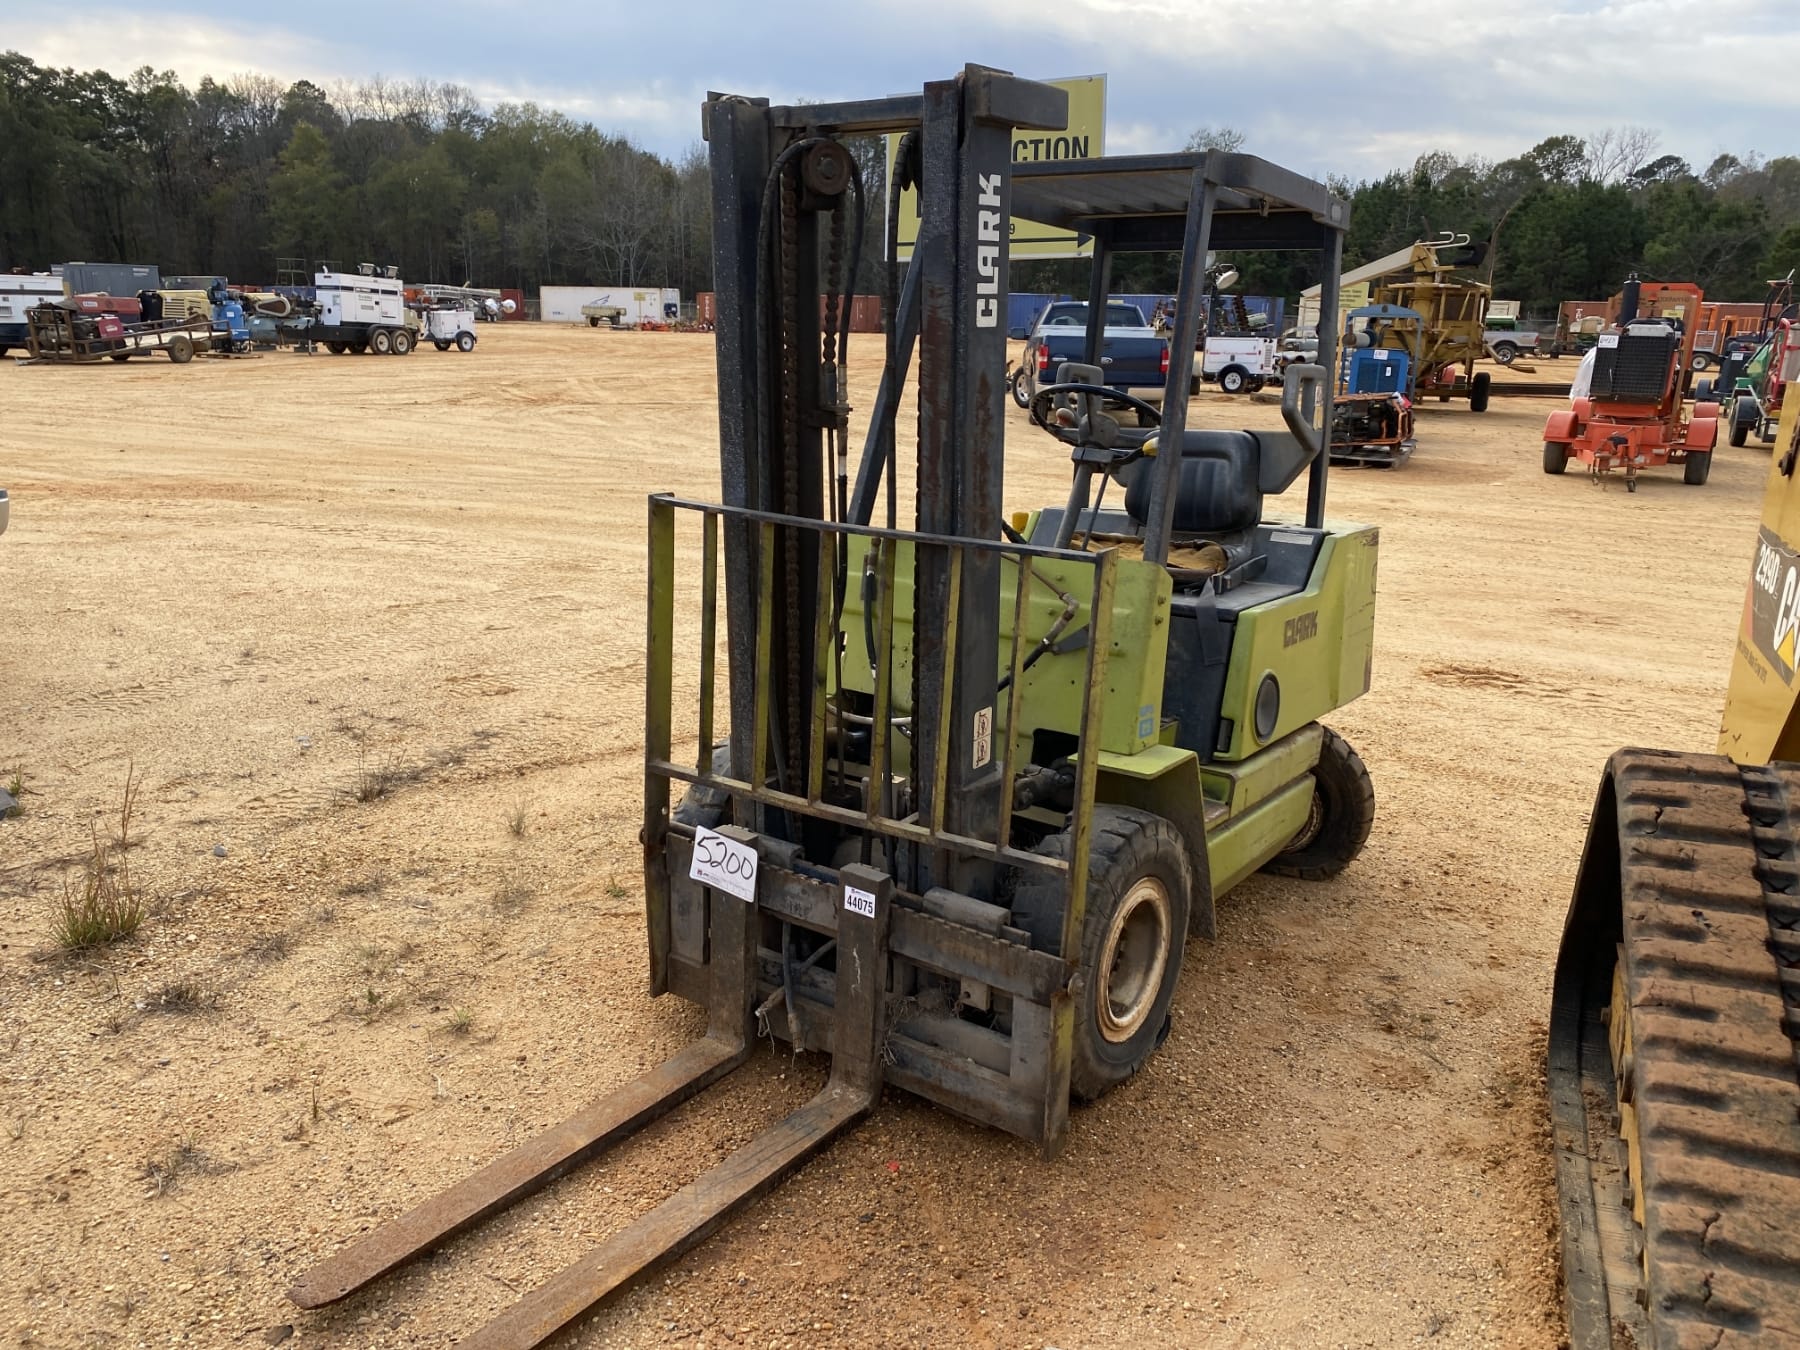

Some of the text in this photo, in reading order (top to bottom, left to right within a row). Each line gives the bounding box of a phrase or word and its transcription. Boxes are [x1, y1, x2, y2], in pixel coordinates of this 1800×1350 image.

[976, 173, 1001, 328] CLARK
[1284, 609, 1319, 648] CLARK
[696, 836, 754, 880] 5200
[847, 895, 873, 914] 44075
